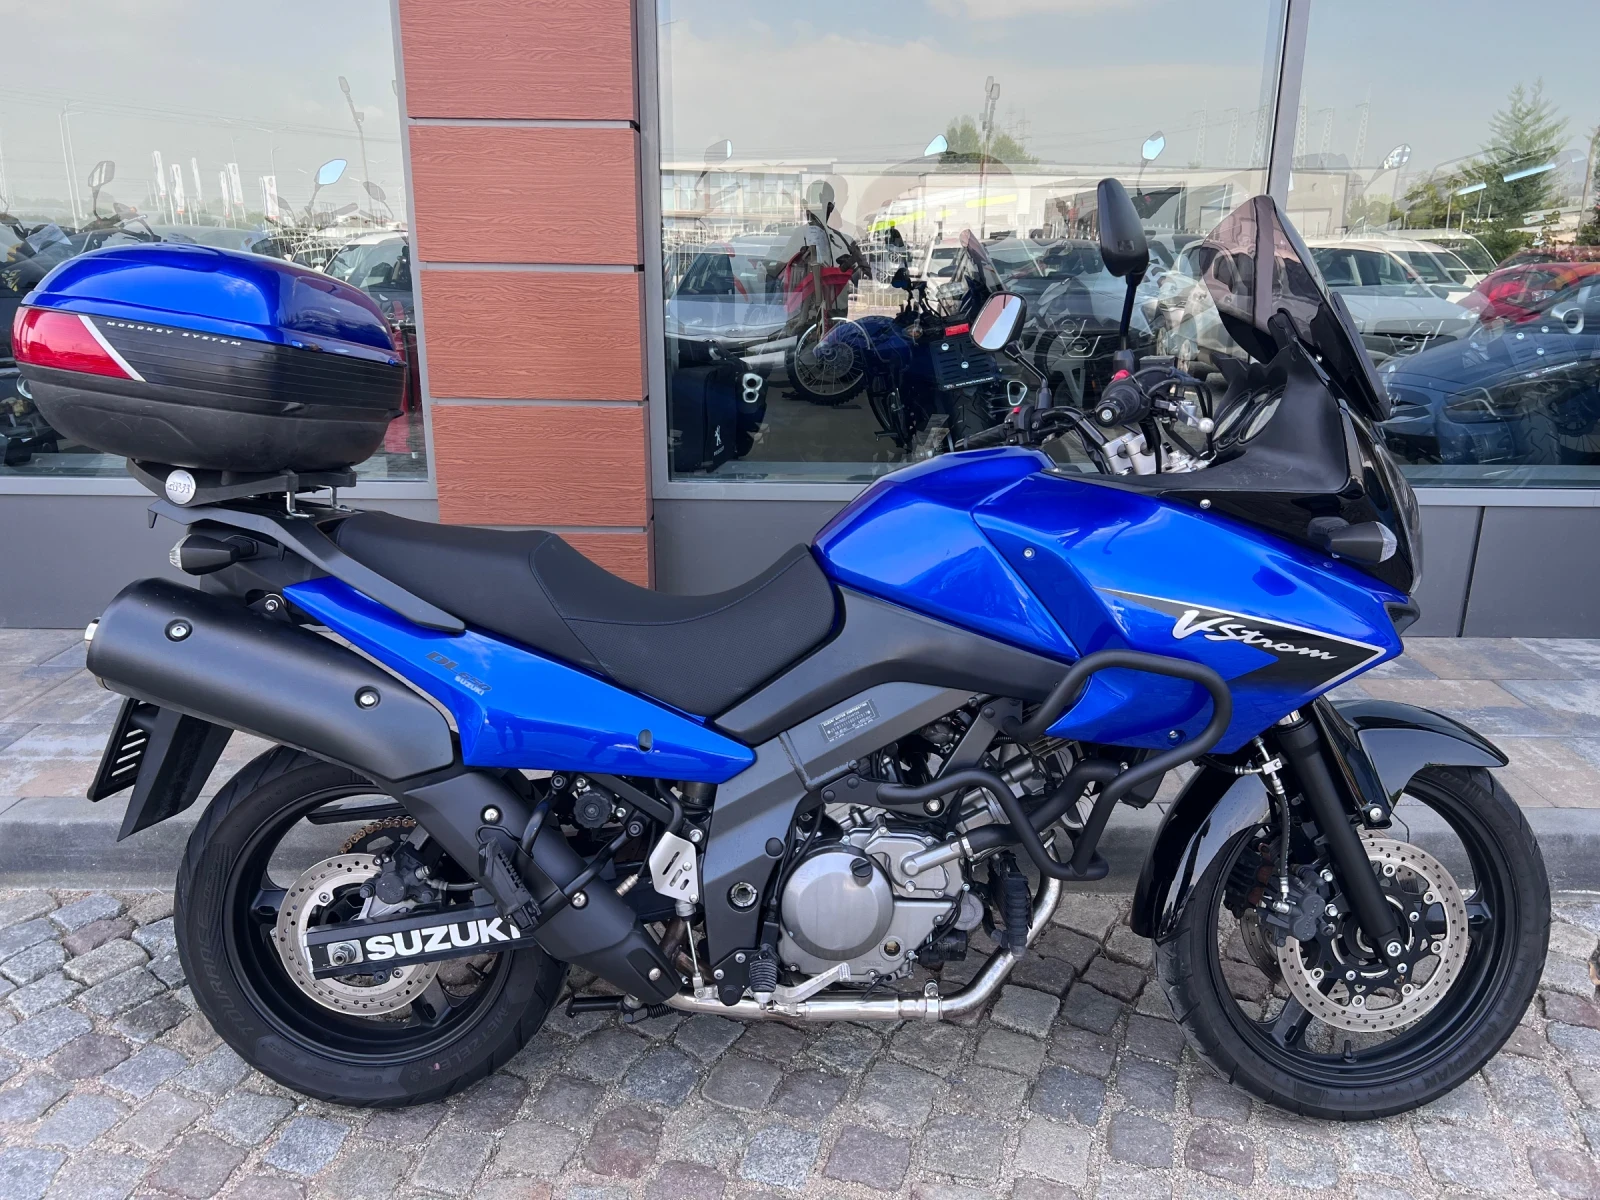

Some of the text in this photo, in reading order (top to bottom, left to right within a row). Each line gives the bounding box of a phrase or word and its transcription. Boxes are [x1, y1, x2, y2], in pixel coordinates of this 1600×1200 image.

[106, 321, 242, 345] MONOKEY SYSTEM
[454, 675, 485, 696] SUZUKI
